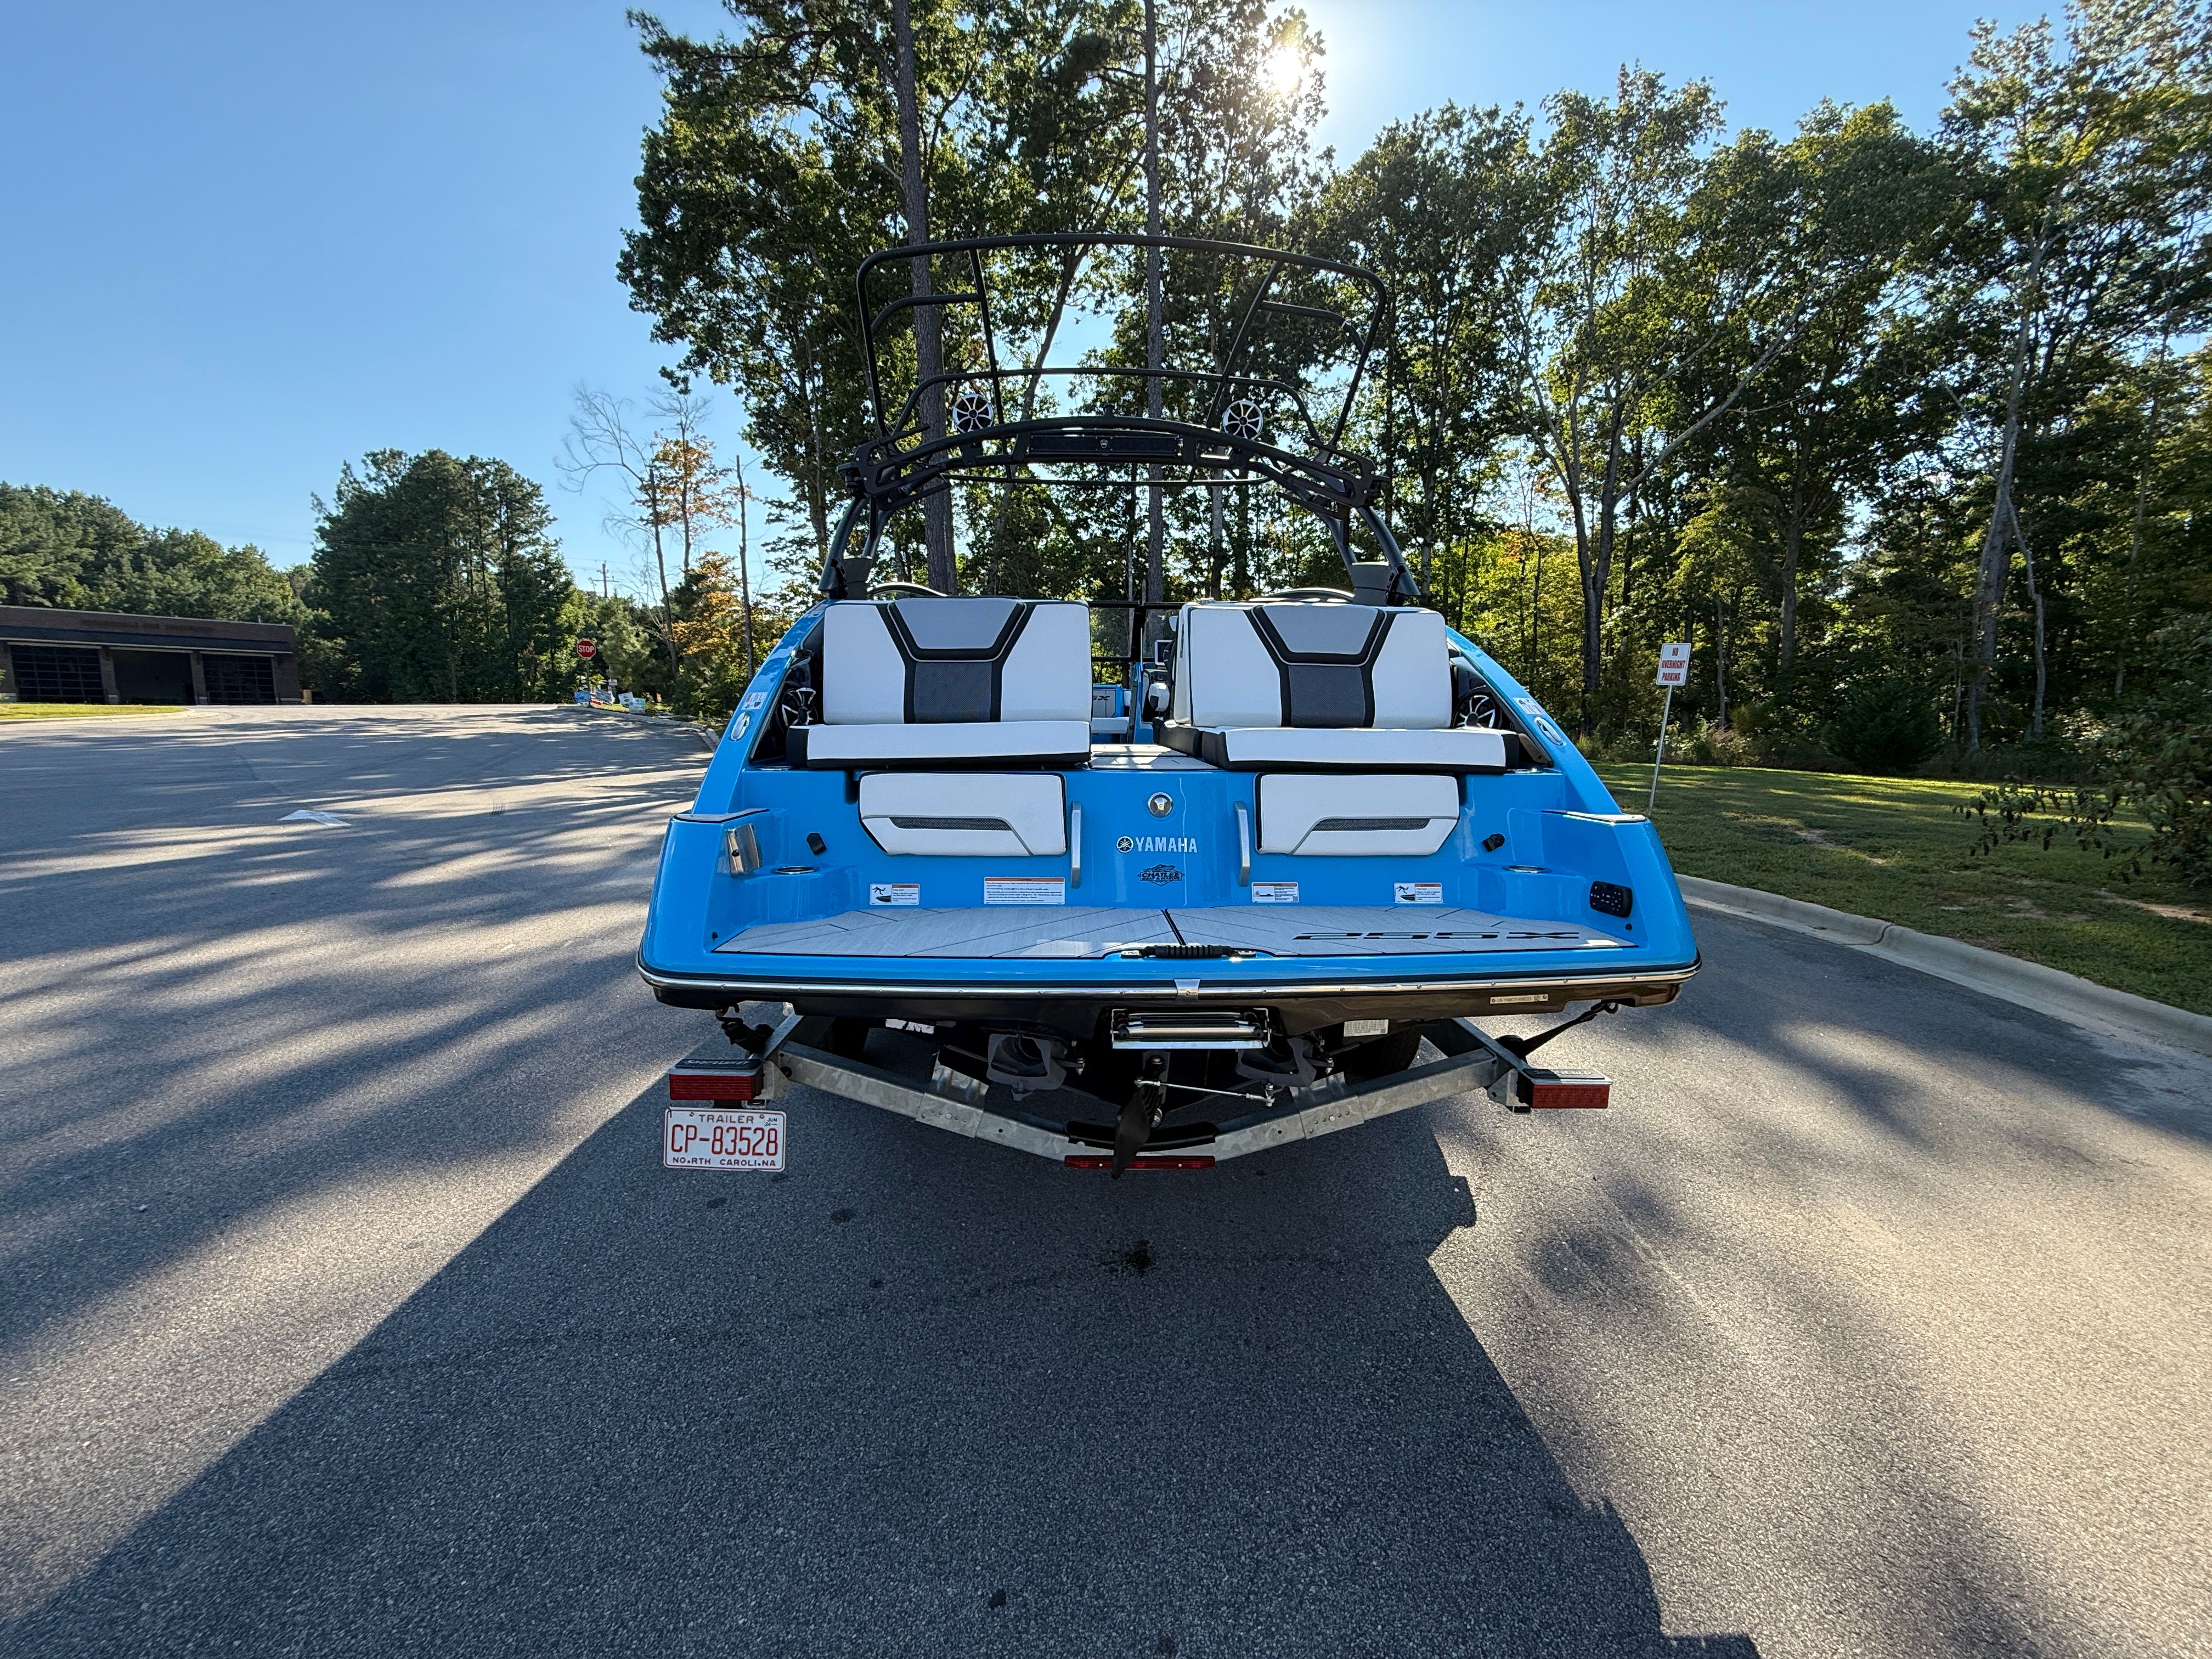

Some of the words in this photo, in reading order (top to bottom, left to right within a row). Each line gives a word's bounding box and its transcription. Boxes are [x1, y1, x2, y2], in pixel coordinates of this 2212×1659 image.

[1672, 647, 1679, 656] NO
[1661, 660, 1686, 669] OVERNIGHT
[1662, 673, 1681, 681] PARKING
[1135, 837, 1198, 853] YAMAHA
[1292, 932, 1579, 940] 255X
[699, 1114, 754, 1124] TRAILER
[671, 1124, 778, 1156] CP-83528
